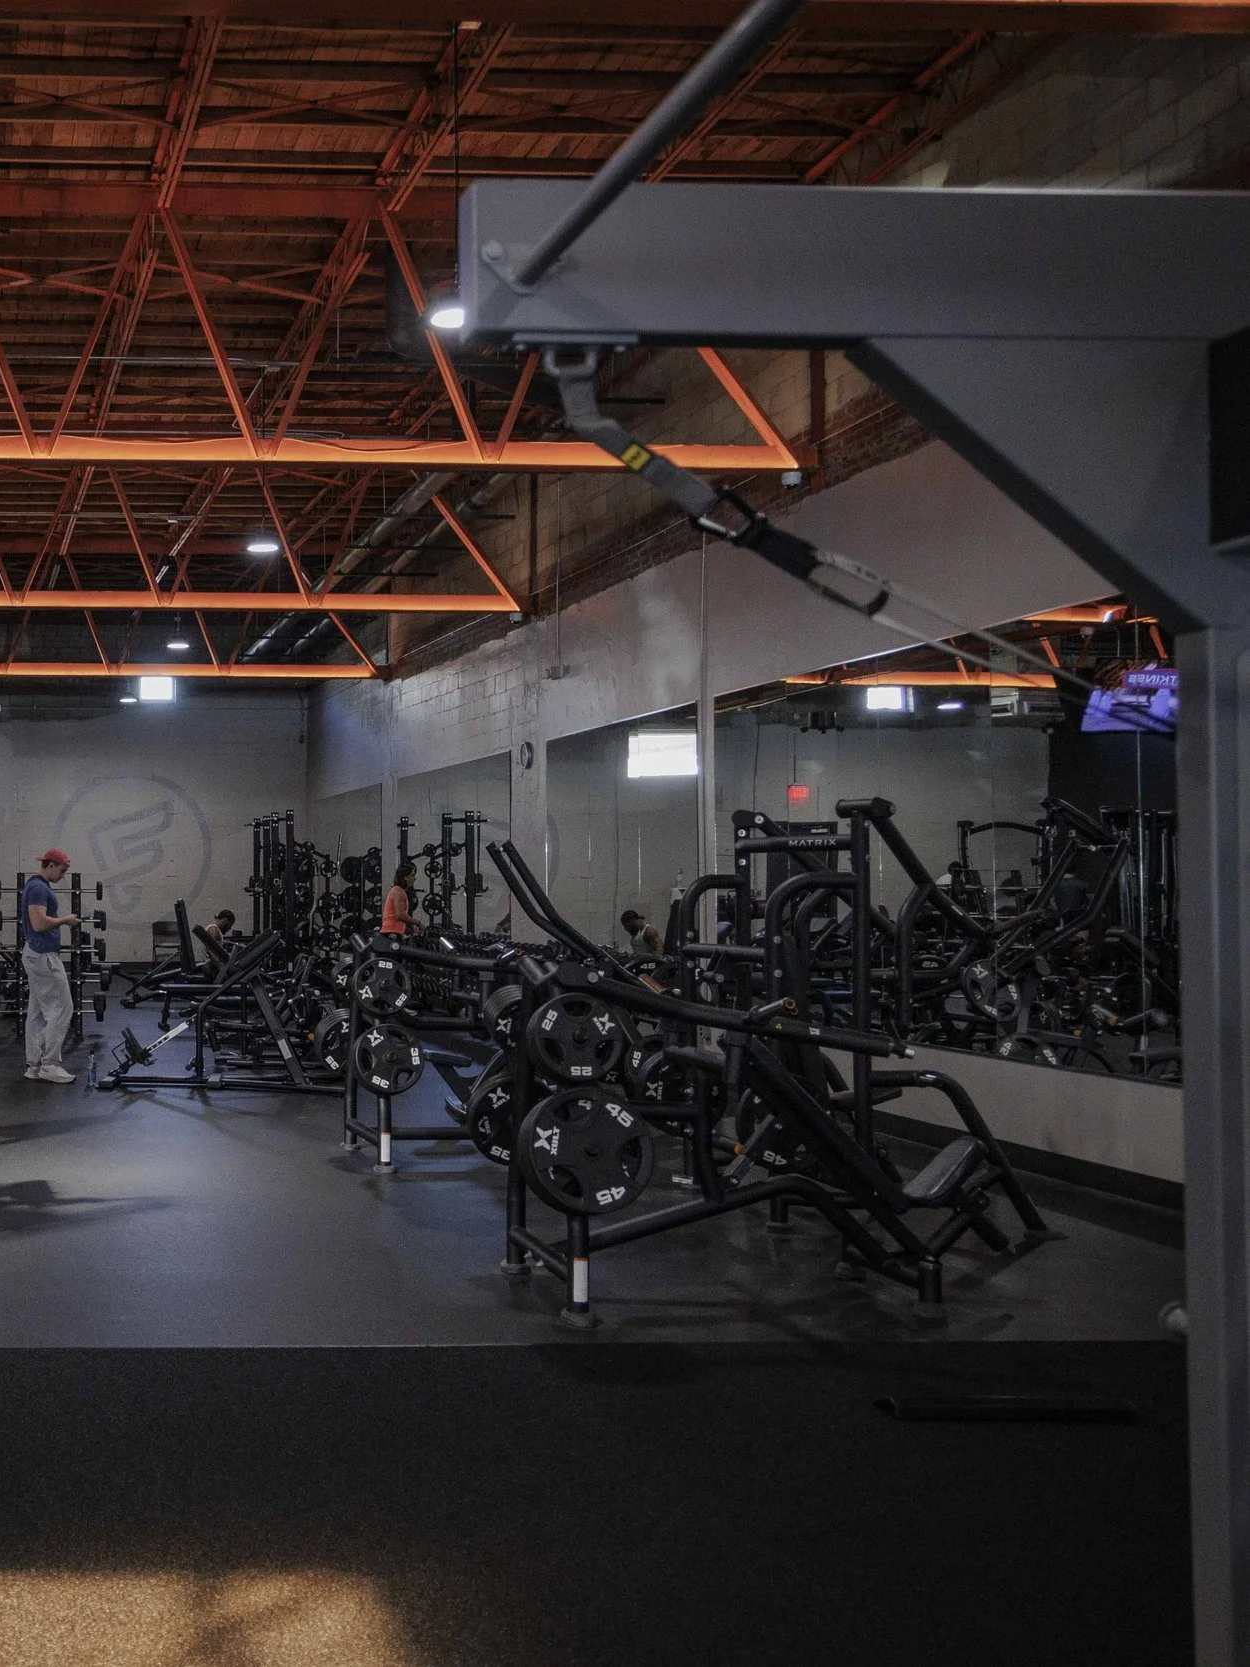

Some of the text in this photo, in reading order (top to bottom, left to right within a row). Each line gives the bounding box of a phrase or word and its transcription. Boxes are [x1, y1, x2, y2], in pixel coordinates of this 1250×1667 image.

[789, 839, 837, 847] MATRIX
[378, 961, 393, 969] 25
[640, 962, 656, 970] 45
[542, 1009, 558, 1031] 25
[593, 1016, 608, 1035] XULT
[410, 1047, 420, 1065] 35
[632, 1051, 642, 1068] 45
[570, 1066, 592, 1076] 25
[371, 1075, 390, 1088] 35
[492, 1094, 510, 1109] XULT
[605, 1102, 634, 1128] 45
[550, 1126, 560, 1155] XULT
[490, 1145, 511, 1161] 35
[762, 1150, 788, 1166] 45
[595, 1186, 626, 1205] 45
